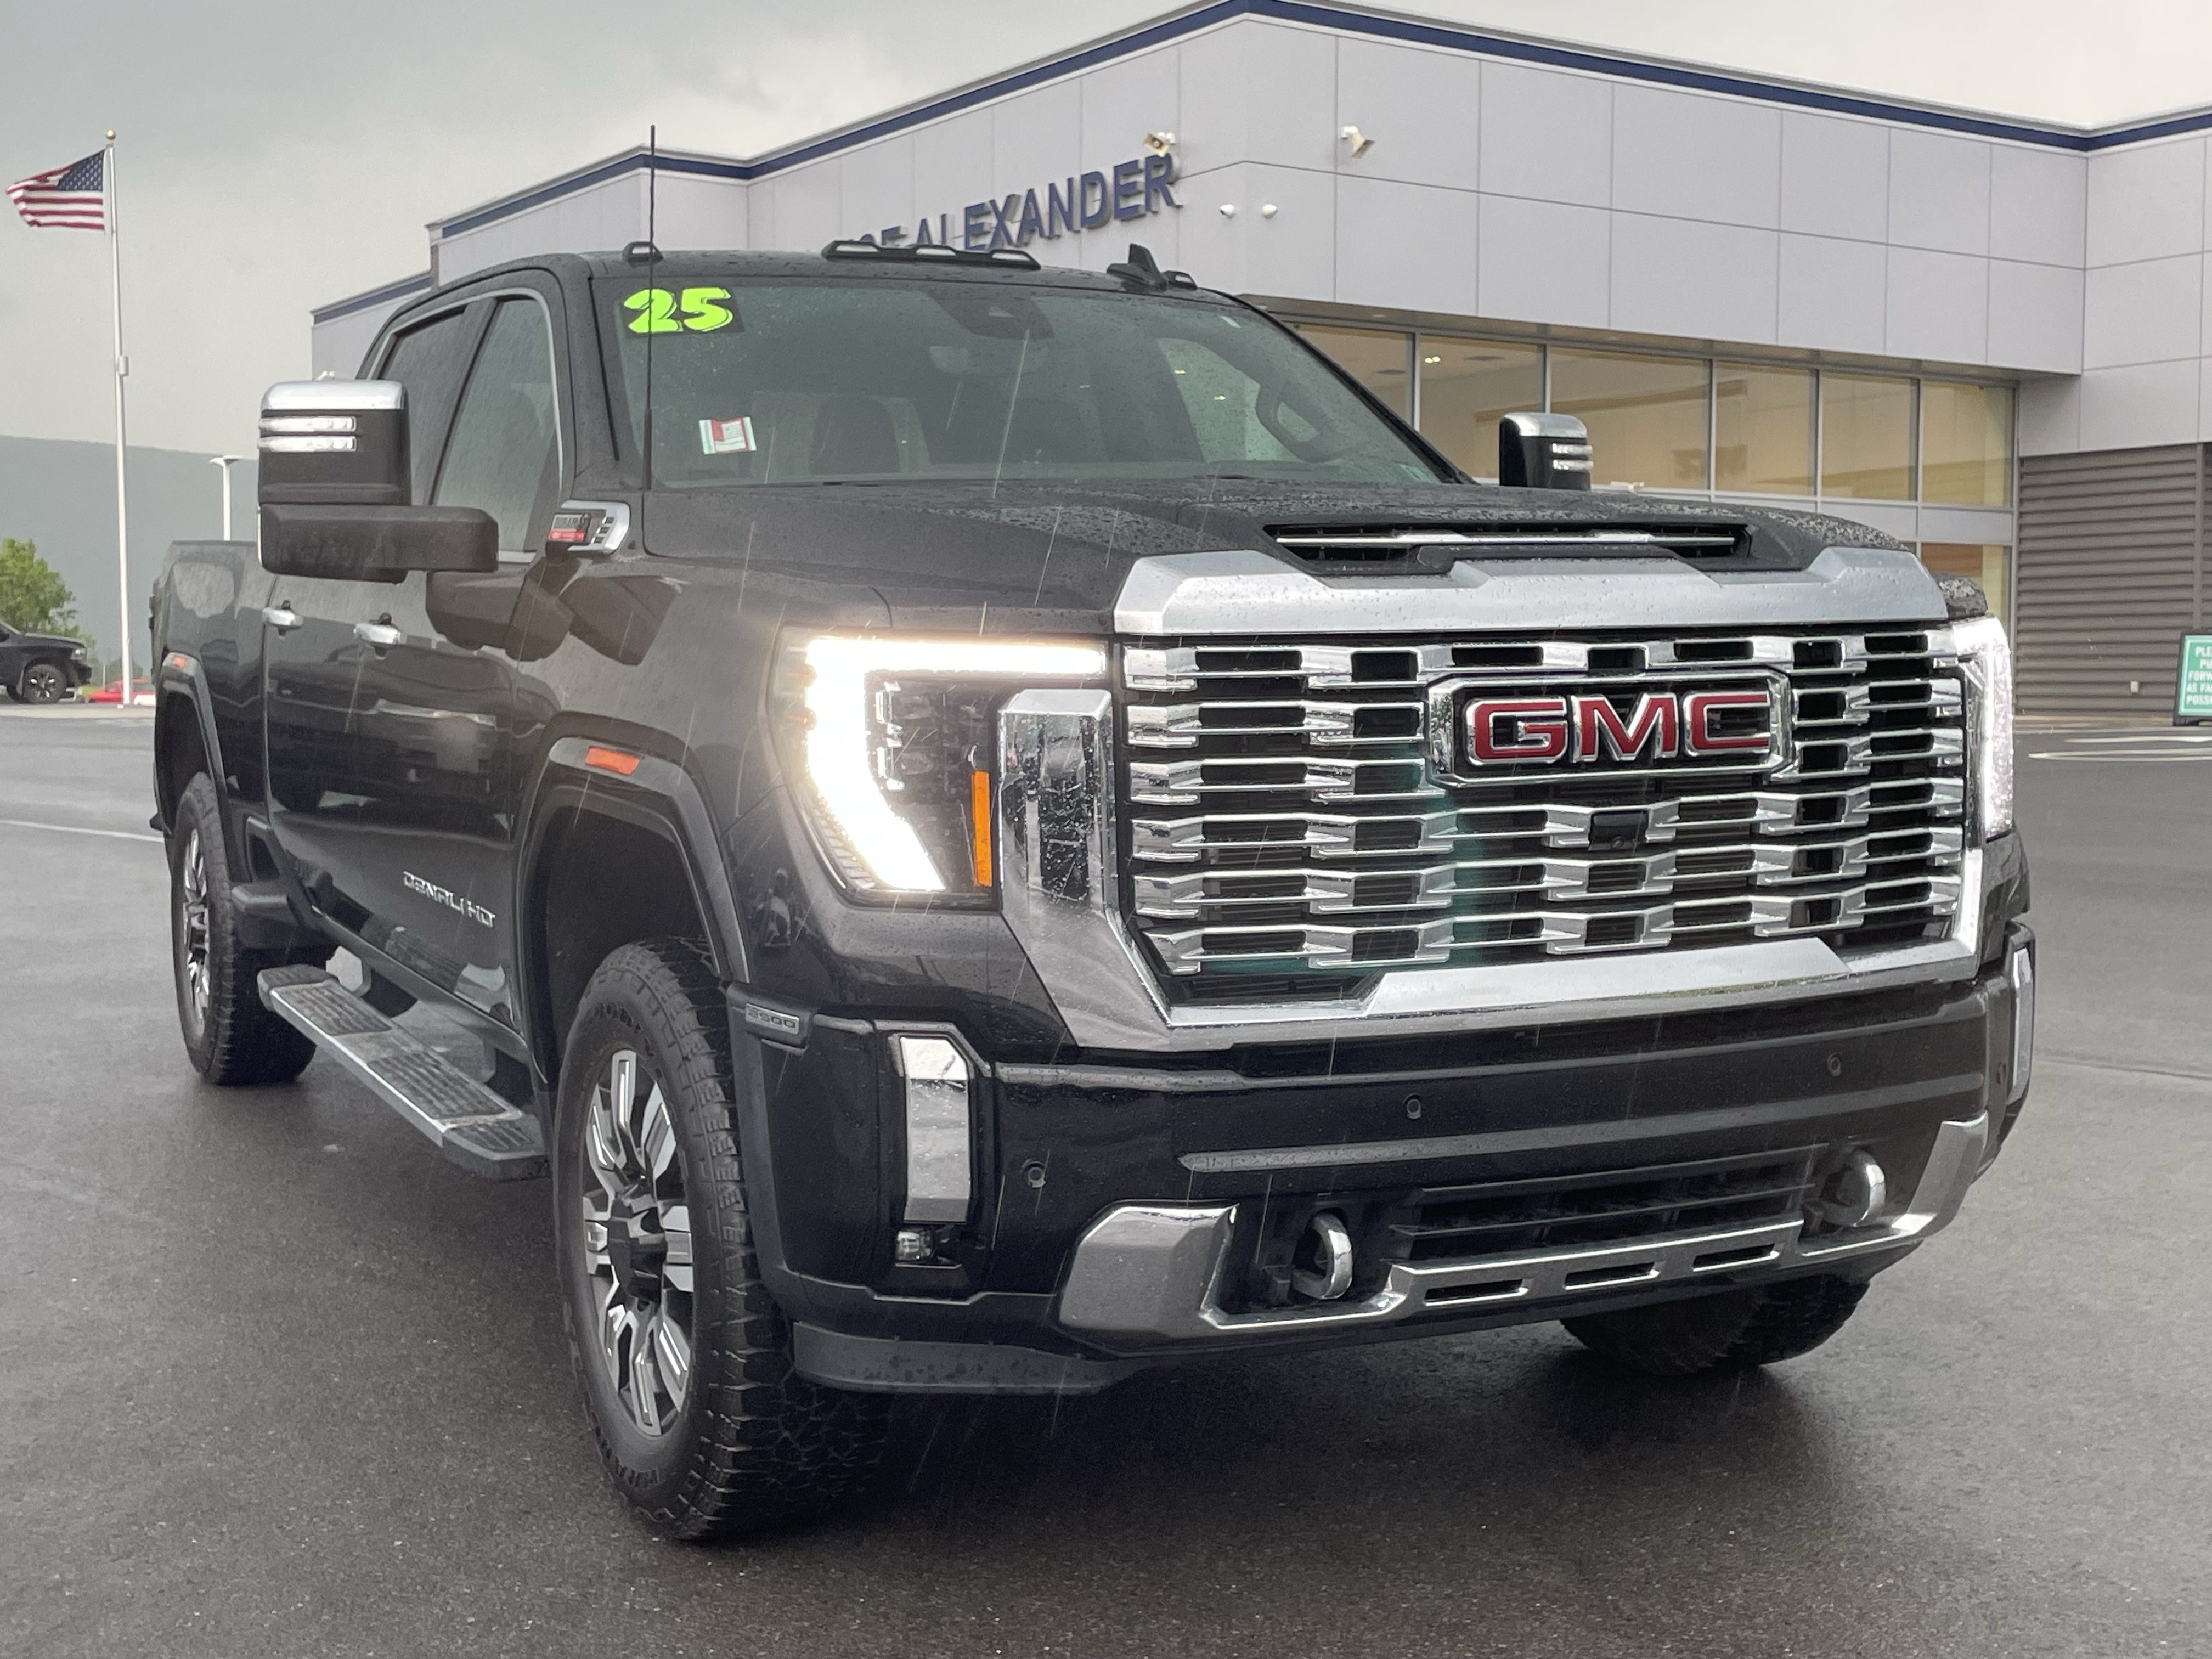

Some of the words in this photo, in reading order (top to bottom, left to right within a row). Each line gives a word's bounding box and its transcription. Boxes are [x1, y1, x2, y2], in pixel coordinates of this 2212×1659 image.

[917, 154, 1181, 250] ALEXANDER
[623, 287, 733, 334] 25
[2186, 682, 2197, 693] AS
[1465, 691, 1771, 766] GMC
[403, 870, 465, 915] DENALI
[466, 900, 495, 928] HD
